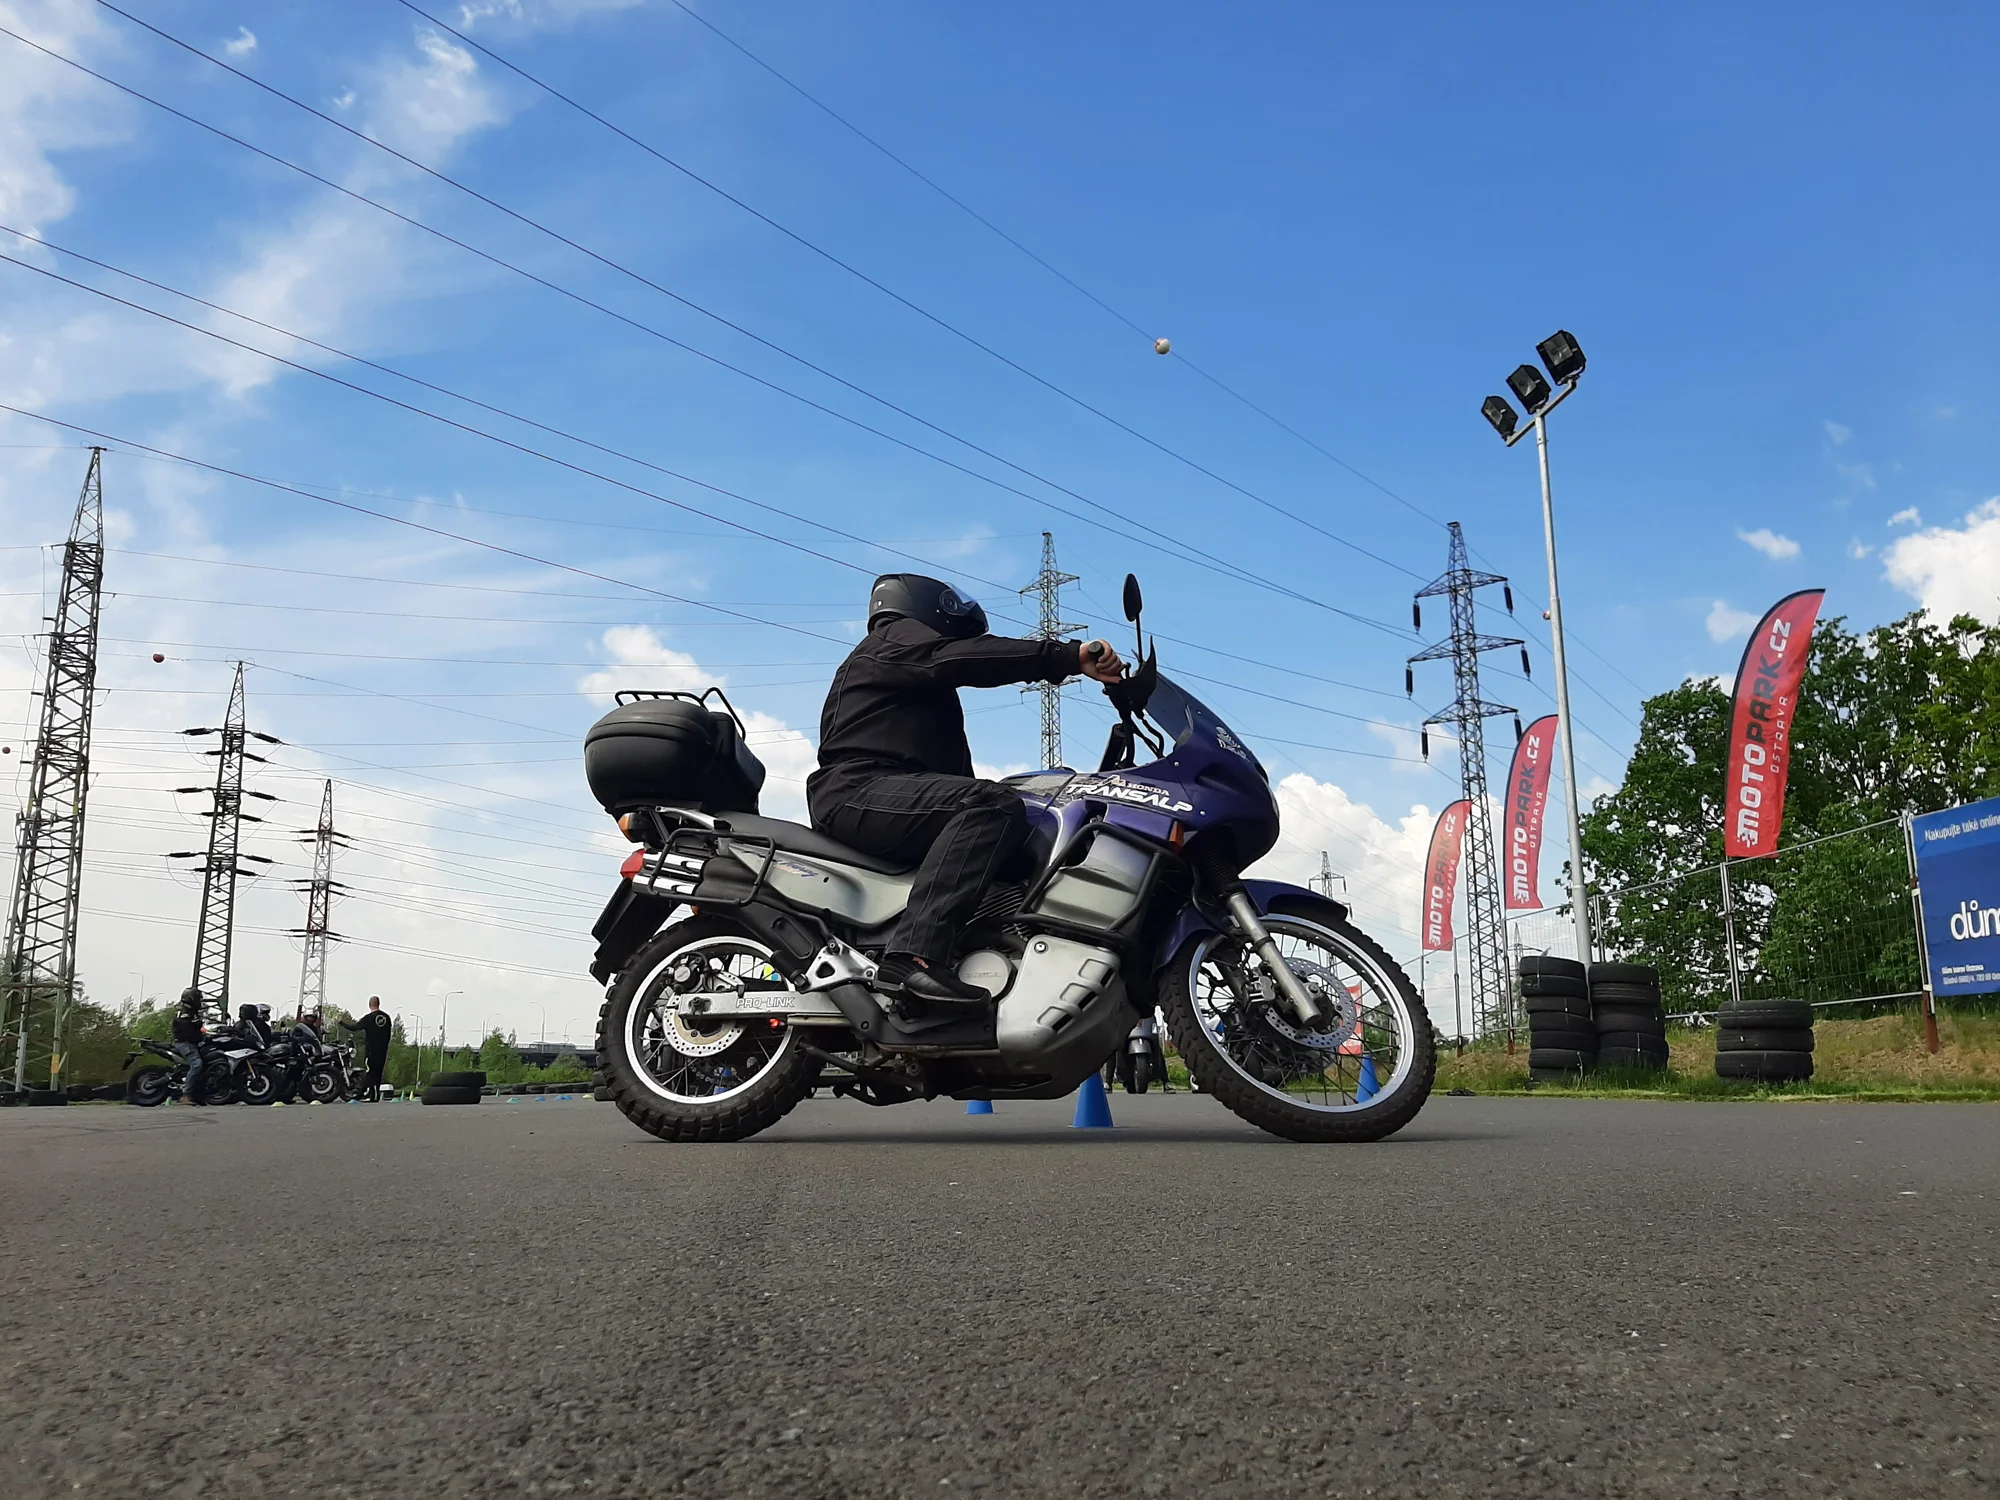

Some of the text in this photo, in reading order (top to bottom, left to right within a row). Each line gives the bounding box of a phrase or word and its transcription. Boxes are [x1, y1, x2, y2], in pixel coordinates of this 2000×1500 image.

[1127, 783, 1169, 796] HONDA
[1065, 783, 1194, 812] TRANSALP
[1925, 824, 1961, 841] Nakupujte
[736, 996, 796, 1009] PRO-LINK
